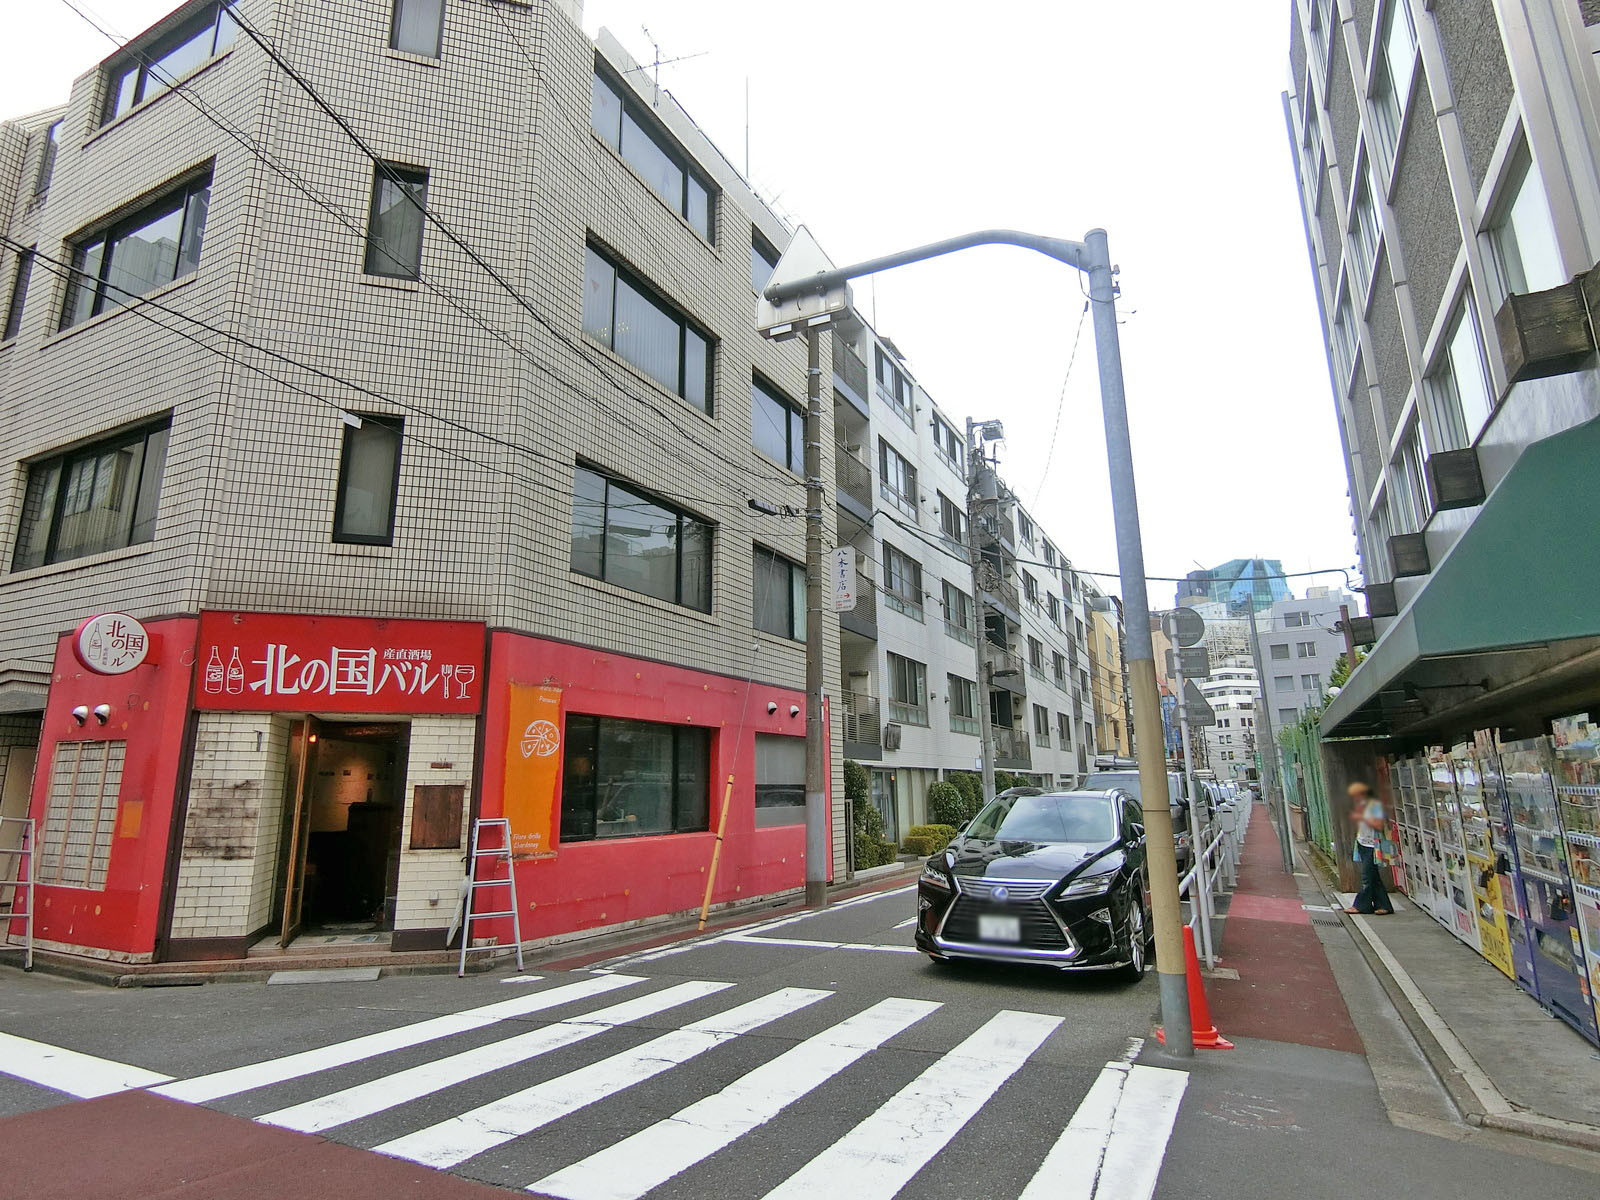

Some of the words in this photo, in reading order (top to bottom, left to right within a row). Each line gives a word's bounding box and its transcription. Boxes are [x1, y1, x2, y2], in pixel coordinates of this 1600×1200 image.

[106, 620, 144, 667] 北の国バル
[383, 648, 432, 660] 産直酒場
[248, 643, 440, 695] 北の国バル
